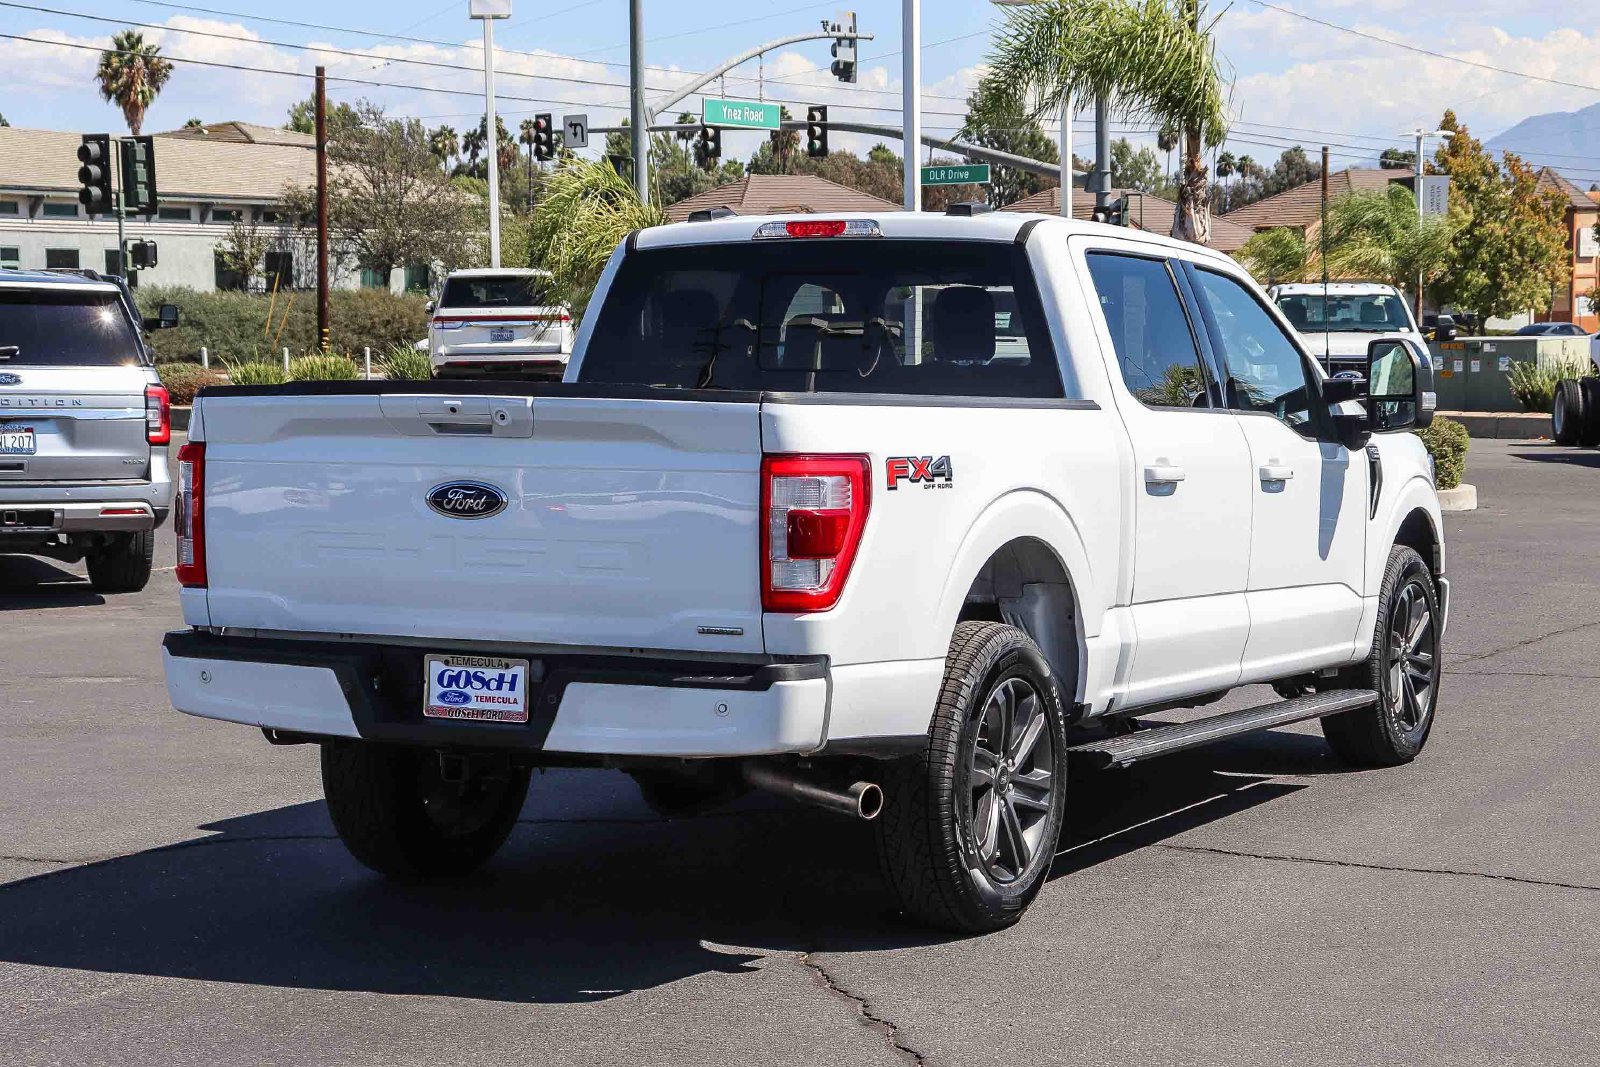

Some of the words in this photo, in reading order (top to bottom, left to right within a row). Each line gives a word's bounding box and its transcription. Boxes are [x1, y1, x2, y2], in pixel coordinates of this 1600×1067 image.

[722, 105, 741, 120] Ynez
[744, 106, 764, 122] Road
[929, 170, 946, 180] DLR
[948, 169, 970, 180] Drive
[885, 455, 953, 491] FX4
[443, 488, 487, 511] Ford
[449, 656, 504, 668] TEMECULA
[444, 692, 464, 703] Ford
[474, 695, 519, 705] TEMECULA
[480, 710, 504, 720] FORD
